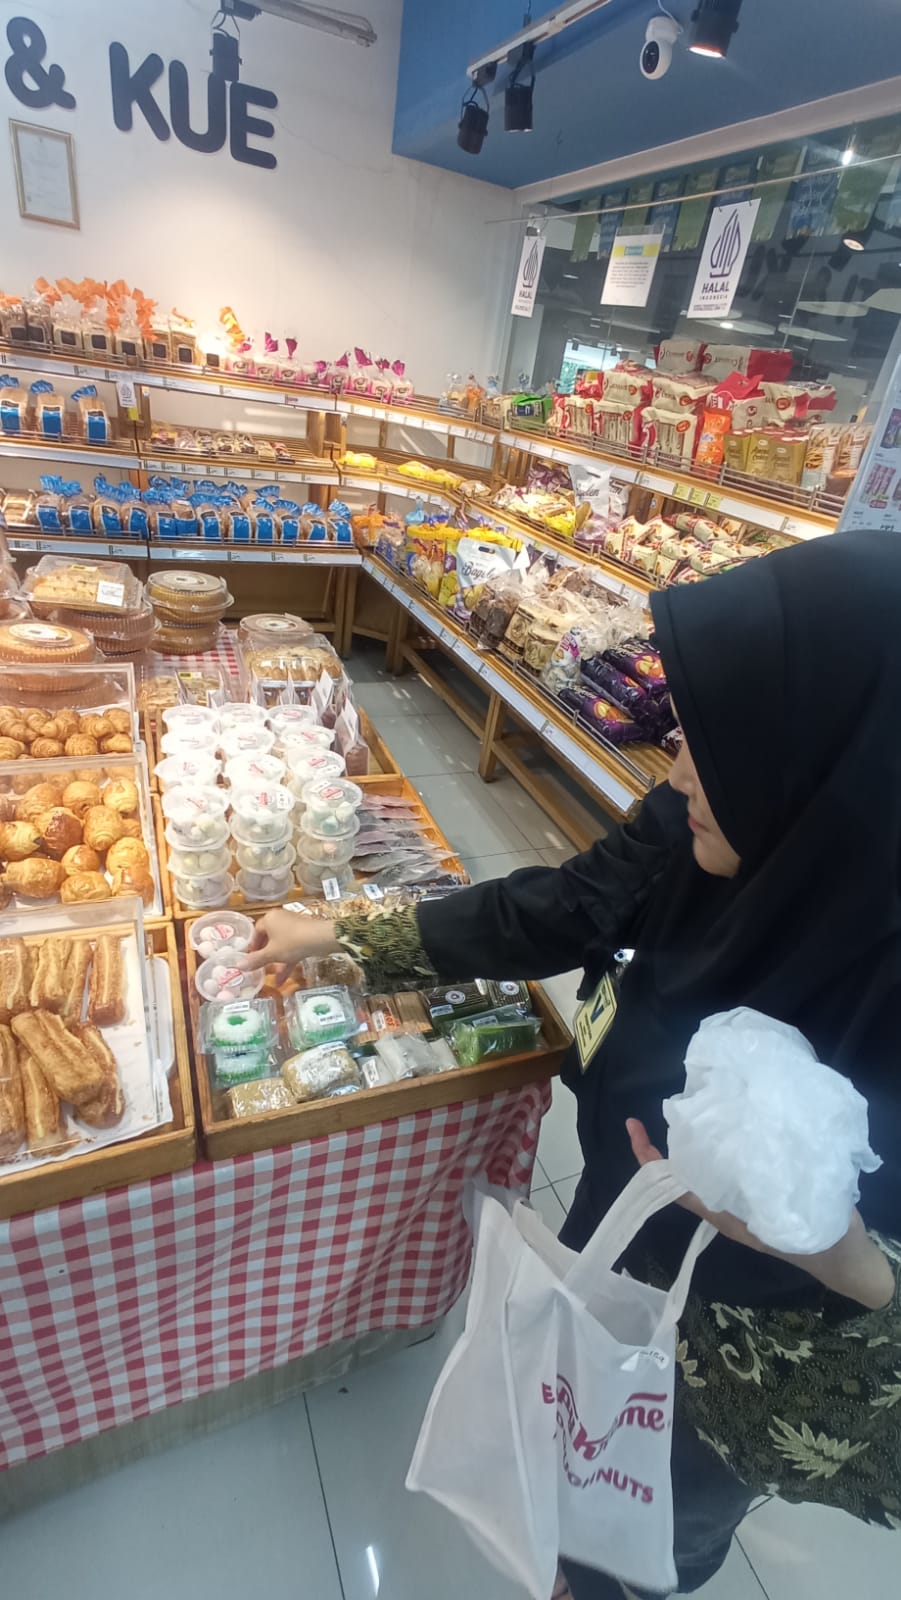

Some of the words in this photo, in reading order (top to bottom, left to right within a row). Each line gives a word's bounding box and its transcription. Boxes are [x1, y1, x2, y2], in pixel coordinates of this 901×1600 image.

[4, 16, 76, 110] &
[109, 41, 278, 169] KUE
[701, 281, 730, 294] HALAL
